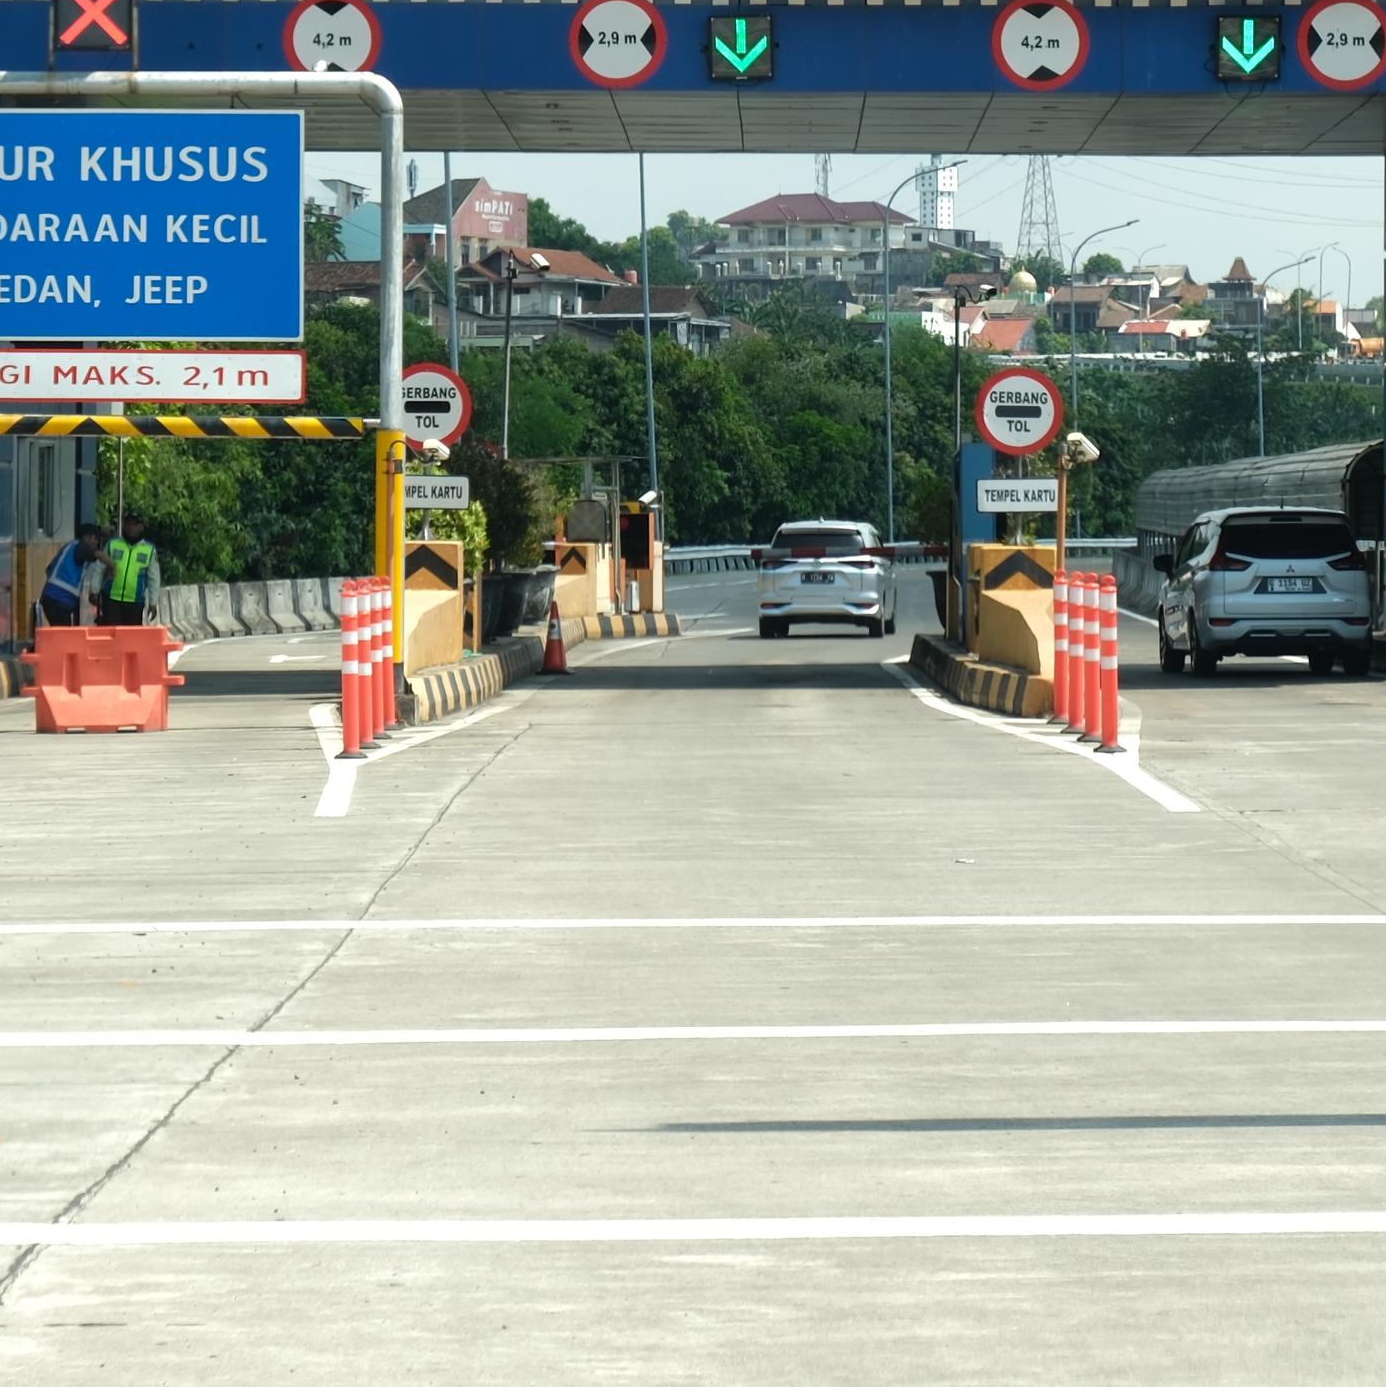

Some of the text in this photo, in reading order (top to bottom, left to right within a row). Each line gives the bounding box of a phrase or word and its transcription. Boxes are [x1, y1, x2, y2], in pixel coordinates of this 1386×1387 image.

[313, 33, 352, 49] 4,2 m
[598, 31, 637, 47] 2,9 m
[1021, 35, 1060, 51] 4,2 m
[1326, 32, 1365, 48] 2,9 m
[80, 146, 269, 182] KHUSUS
[166, 214, 268, 244] KECIL
[125, 275, 209, 304] JEEP
[53, 365, 161, 386] MAKS.
[990, 391, 1048, 404] GERBANG
[415, 415, 440, 428] TOL
[1007, 420, 1031, 432] TOL
[431, 486, 462, 499] KARTU
[985, 489, 1055, 502] TEMPEL KARTU
